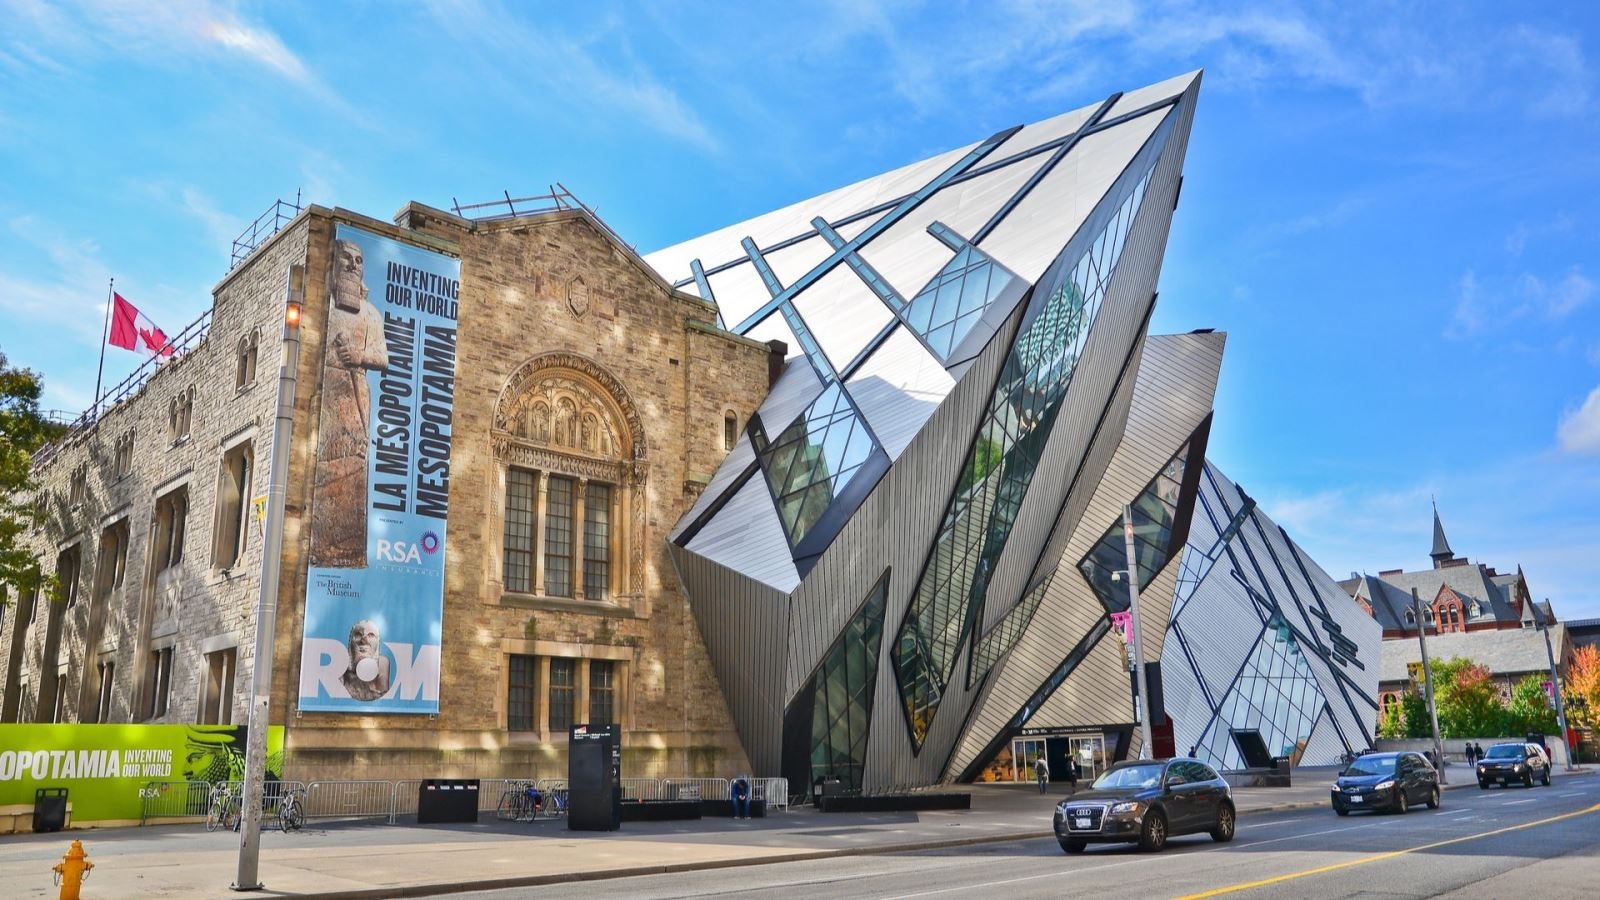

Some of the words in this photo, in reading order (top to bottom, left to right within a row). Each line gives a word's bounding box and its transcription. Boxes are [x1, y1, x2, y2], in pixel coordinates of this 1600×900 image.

[387, 261, 459, 300] INVENTING
[386, 284, 412, 305] OUR
[415, 292, 458, 321] WORLD
[372, 311, 416, 477] MÉSOPOTAMIE
[416, 326, 457, 520] MESOPOTAMIA
[373, 484, 407, 513] LA
[376, 539, 422, 565] RSA
[327, 579, 352, 590] British
[327, 588, 360, 598] Museum
[301, 637, 441, 702] ROM
[0, 750, 120, 781] OPOTAMIA
[123, 749, 172, 763] INVENTING
[122, 764, 140, 778] OUR
[142, 764, 171, 777] WORLD
[138, 788, 160, 798] RSA
